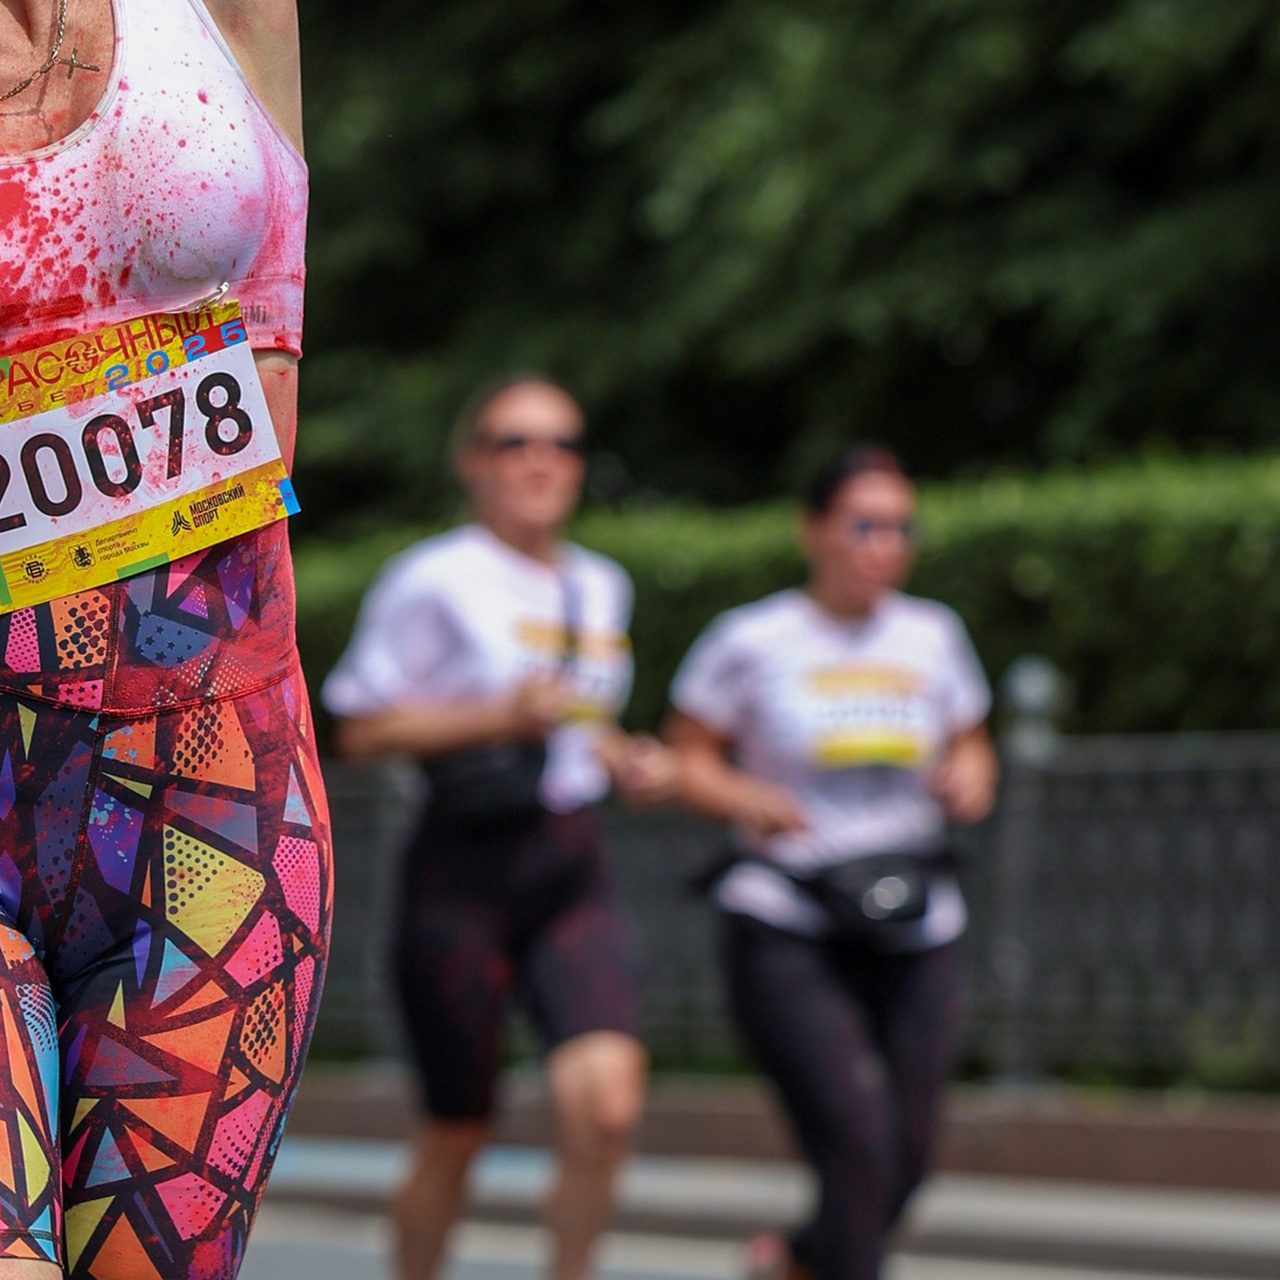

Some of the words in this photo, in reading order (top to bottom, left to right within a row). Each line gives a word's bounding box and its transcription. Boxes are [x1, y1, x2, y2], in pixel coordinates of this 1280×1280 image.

[105, 319, 246, 391] 2025
[189, 483, 245, 516] МОСКОВСКИЙ
[193, 508, 219, 528] СПОРТ
[95, 528, 138, 546] Департамент
[98, 543, 120, 554] спорта
[100, 551, 123, 561] города
[124, 541, 150, 555] Москвы
